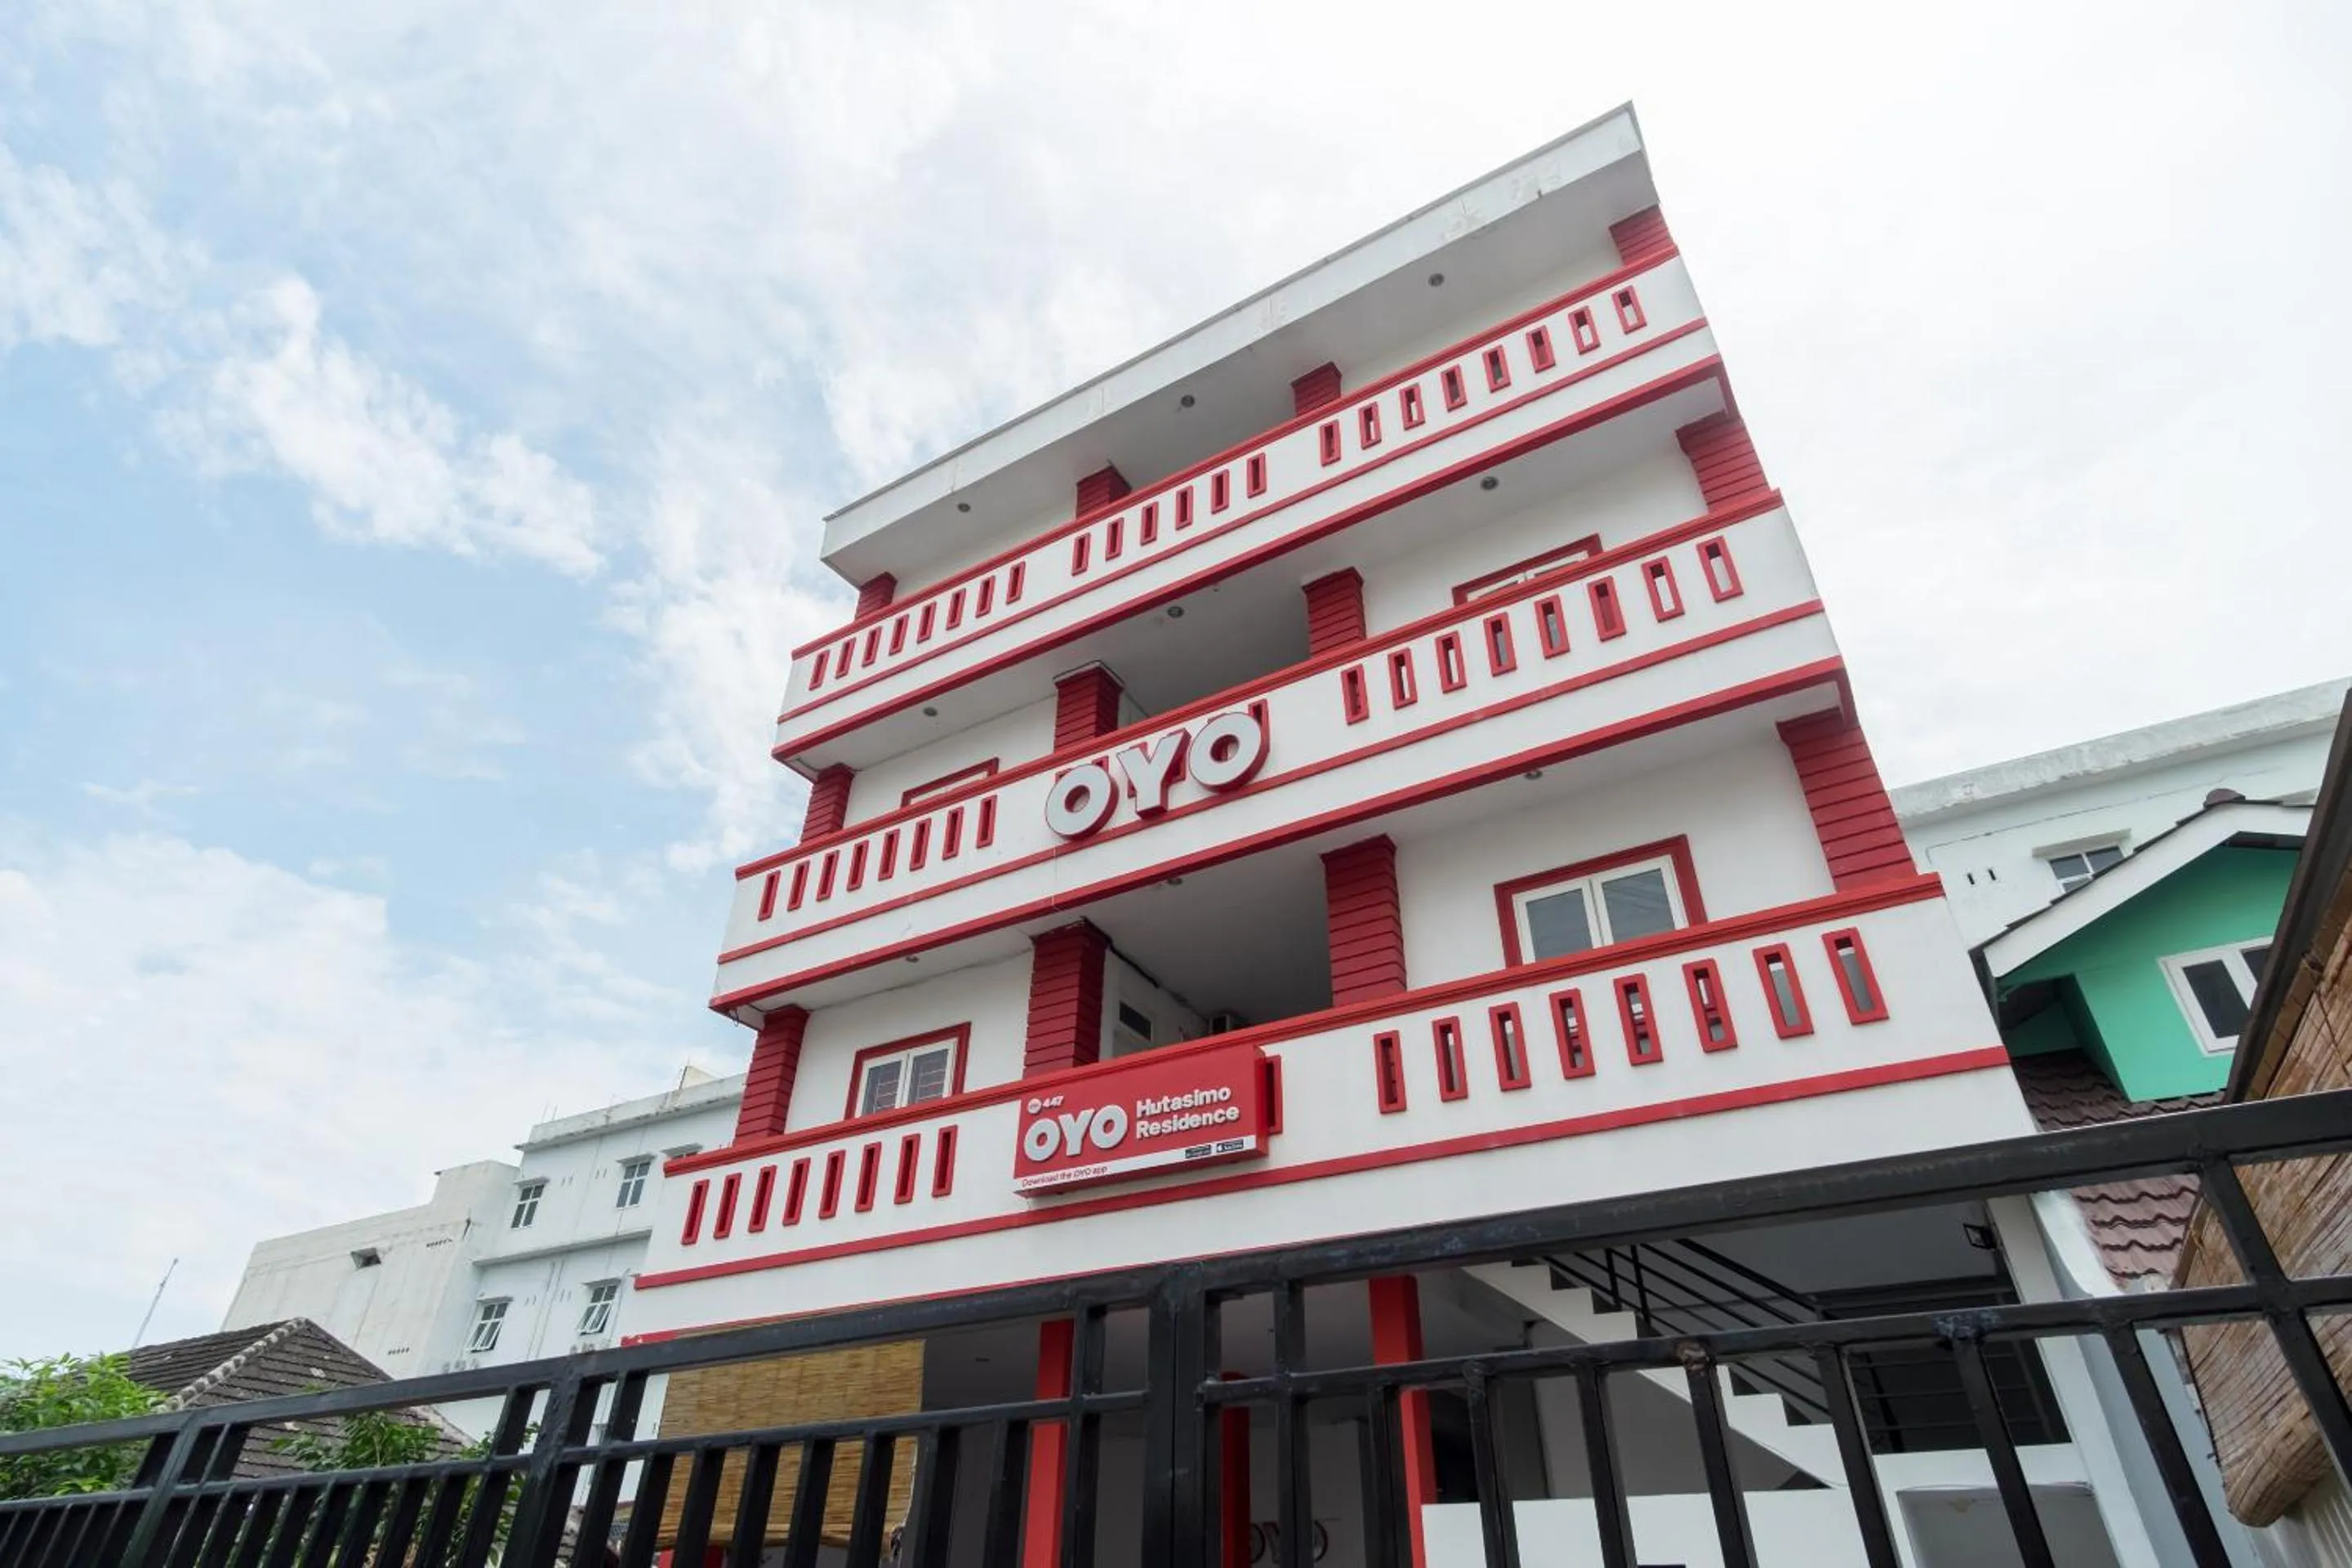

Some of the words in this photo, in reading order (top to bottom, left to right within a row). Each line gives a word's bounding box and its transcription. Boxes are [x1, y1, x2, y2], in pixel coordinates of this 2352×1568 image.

[1045, 711, 1267, 840] OYO
[1042, 1095, 1064, 1107] 447
[1136, 1086, 1232, 1118] Hutasimo
[1023, 1104, 1129, 1162] OYO
[1136, 1105, 1240, 1139] Residence
[1022, 1172, 1059, 1187] Download
[1060, 1171, 1072, 1179] the
[1073, 1168, 1092, 1178] OYO
[1093, 1165, 1108, 1175] app
